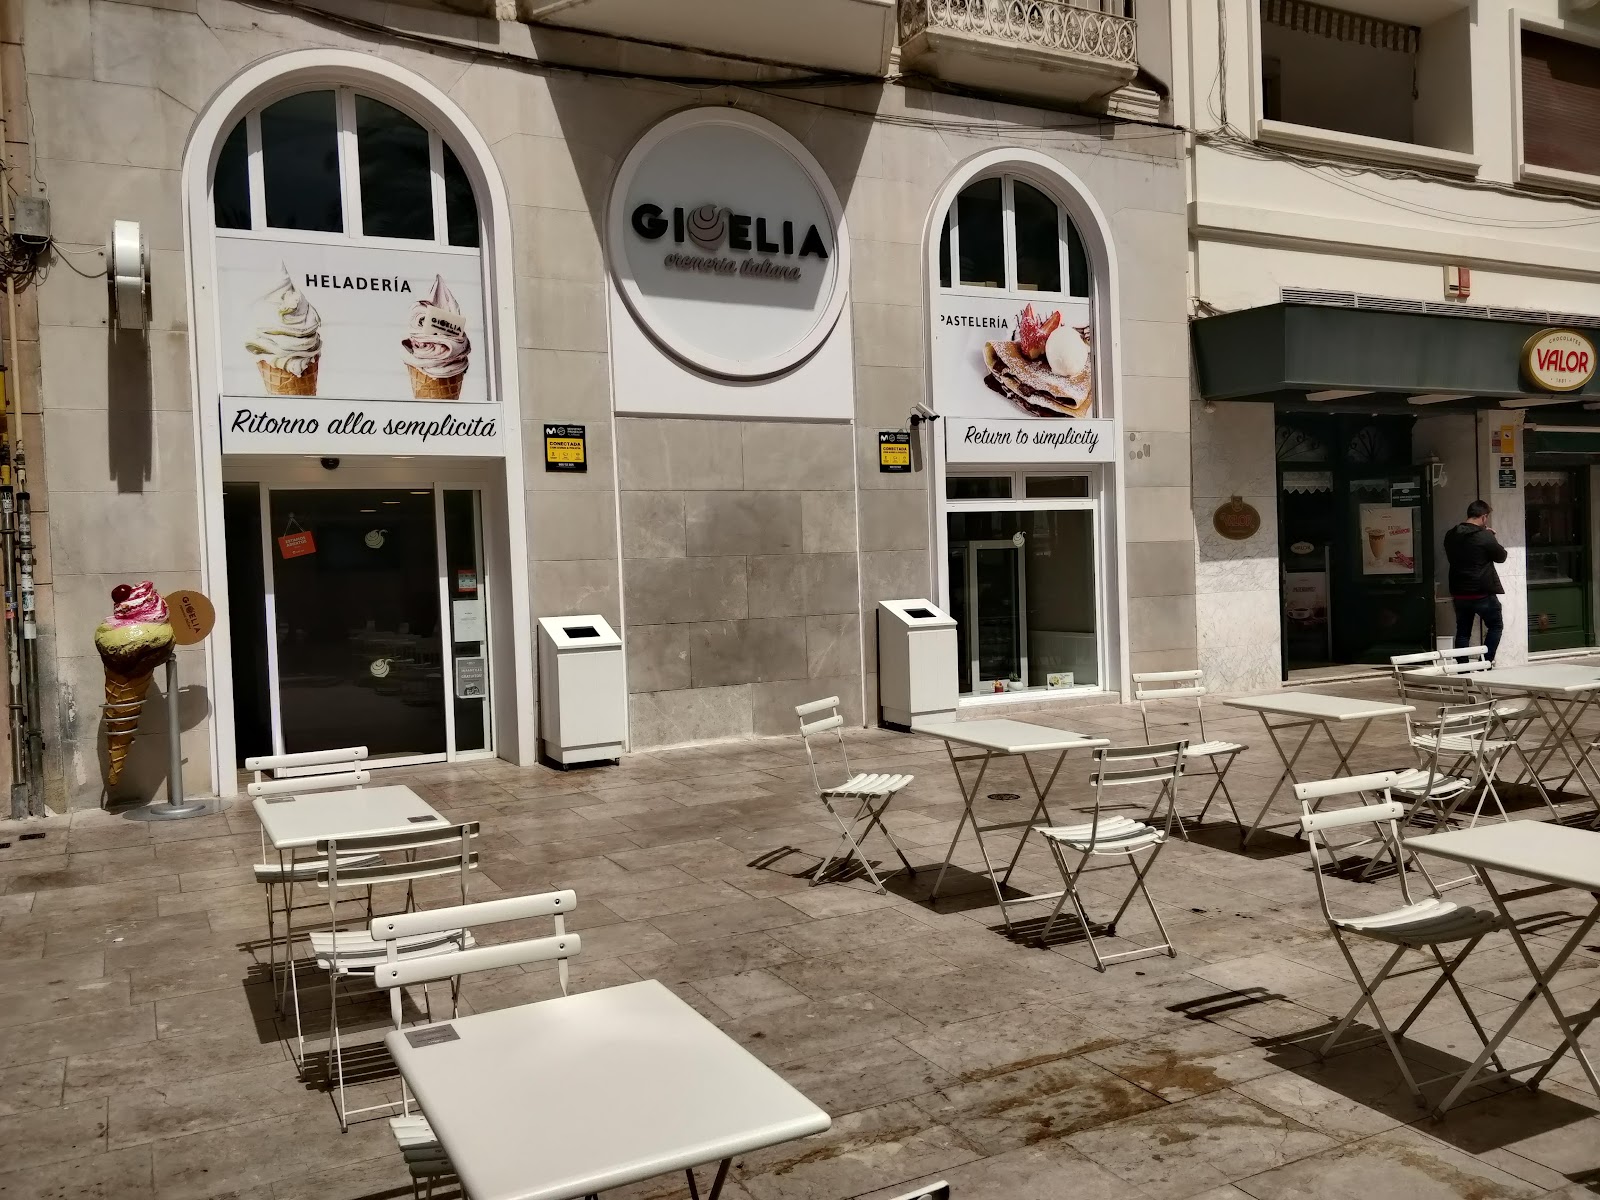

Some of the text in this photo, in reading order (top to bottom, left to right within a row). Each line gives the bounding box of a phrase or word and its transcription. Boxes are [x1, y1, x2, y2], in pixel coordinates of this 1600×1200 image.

[631, 203, 829, 259] GIOELIA
[739, 257, 801, 281] italiana
[305, 273, 412, 293] HELADERÍA
[1548, 335, 1581, 346] CHOCOLATES
[1536, 348, 1589, 373] VALOR
[231, 409, 497, 442] Ritorno alla semplicitá
[964, 425, 1100, 454] Return to simplicity
